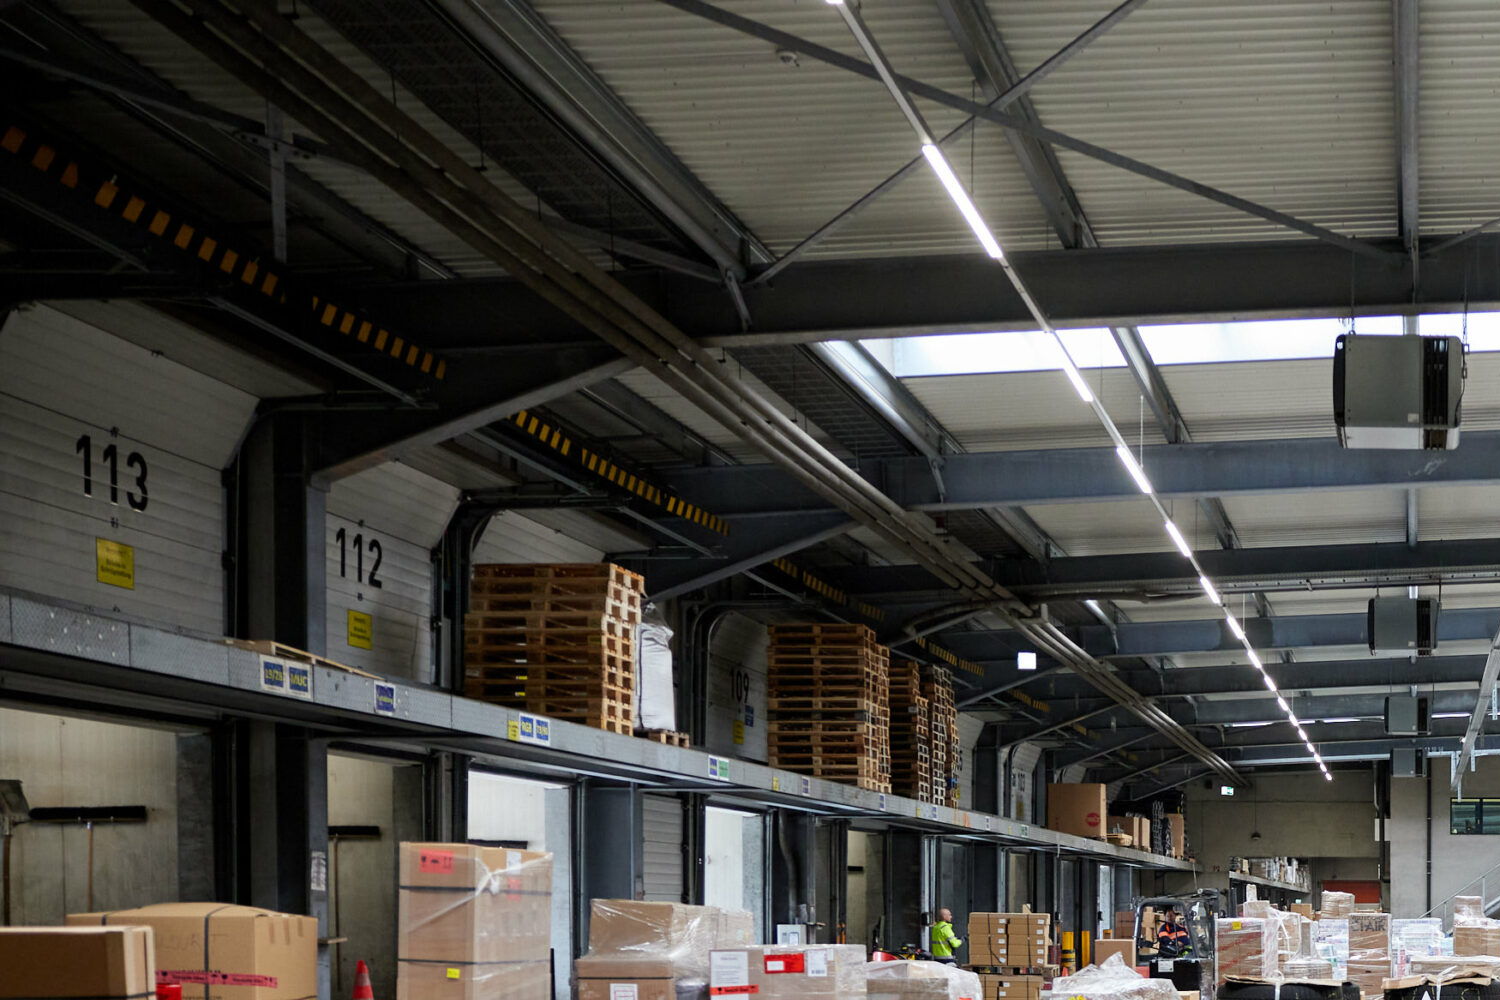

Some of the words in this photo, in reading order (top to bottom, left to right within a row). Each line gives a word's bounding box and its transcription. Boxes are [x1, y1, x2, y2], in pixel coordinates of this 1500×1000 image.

[76, 434, 149, 513] 113
[336, 527, 382, 589] 112
[730, 667, 750, 704] 109
